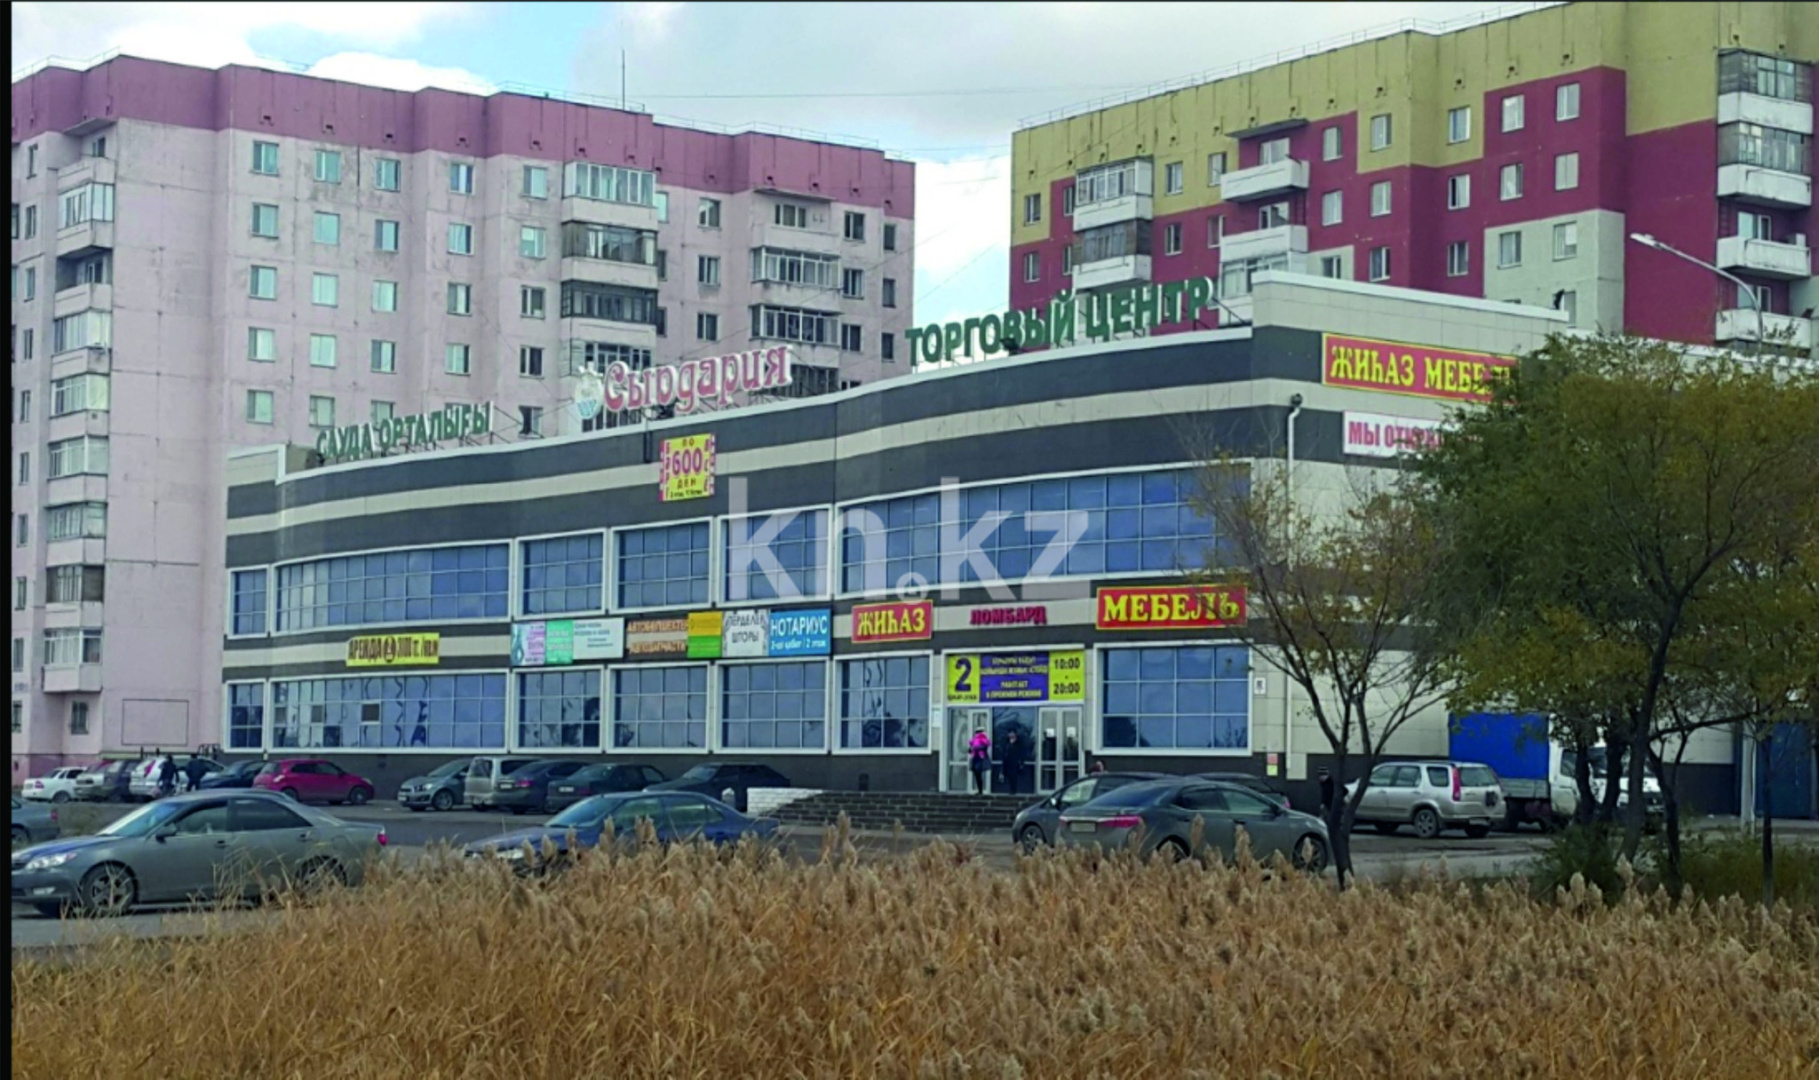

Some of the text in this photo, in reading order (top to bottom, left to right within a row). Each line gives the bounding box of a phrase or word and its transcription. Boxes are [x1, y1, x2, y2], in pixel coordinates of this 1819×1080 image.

[905, 276, 1214, 367] ТОРГОВЫЙ ЦЕНТР
[604, 345, 793, 414] Сырдария
[316, 423, 376, 460] САУДА
[1349, 421, 1380, 446] МЫ
[672, 447, 703, 476] 600
[970, 606, 1047, 625] ЛОМБАРД
[1103, 592, 1240, 622] МЕБЕЛЬ
[770, 615, 829, 637] НОТАРИУС
[858, 607, 925, 636] ЖИҺАЗ
[349, 637, 382, 661] АРЕНДА
[731, 630, 760, 643] ШТОРЫ
[955, 657, 972, 691] 2
[1054, 658, 1081, 669] 10:00
[1053, 682, 1081, 694] 20:00
